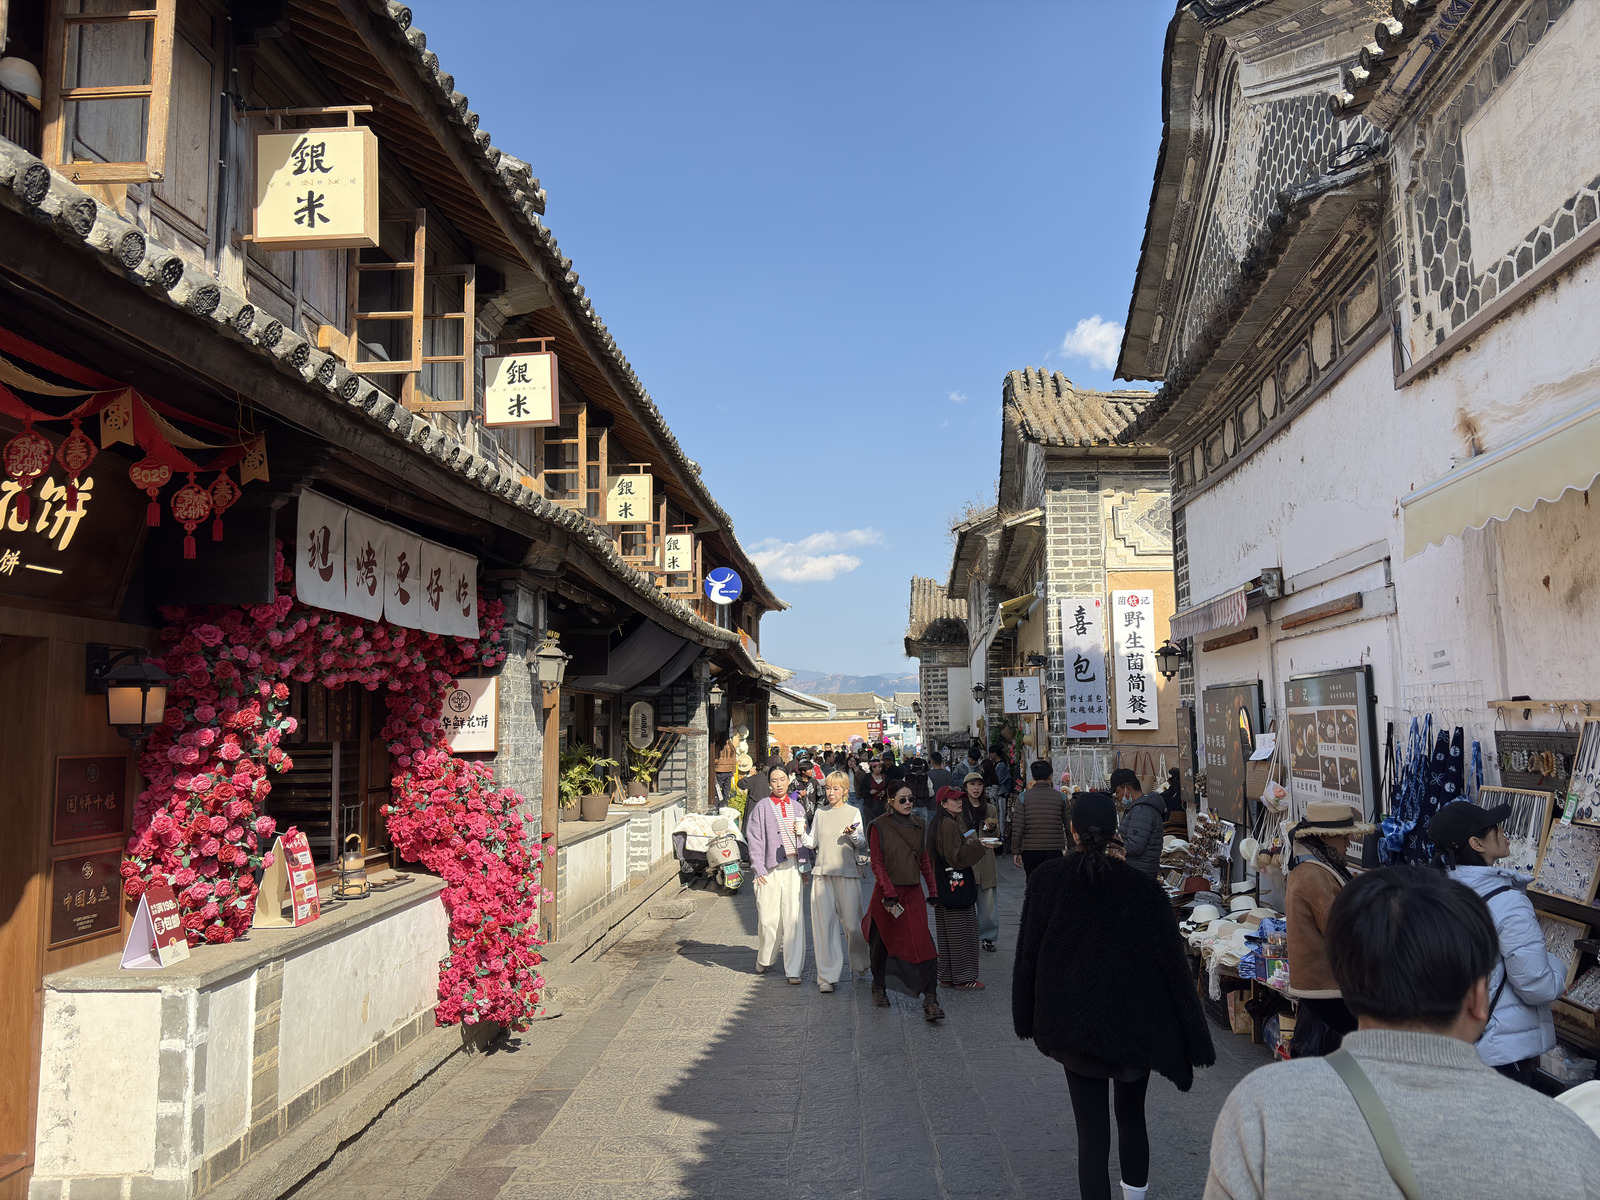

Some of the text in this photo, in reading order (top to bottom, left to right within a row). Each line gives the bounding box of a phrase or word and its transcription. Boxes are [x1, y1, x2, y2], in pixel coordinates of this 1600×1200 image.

[291, 137, 334, 228] 銀米
[506, 360, 532, 417] 銀米
[132, 465, 170, 483] 2026
[617, 478, 636, 519] 銀米
[308, 525, 471, 618] 现烤更好吃
[666, 537, 681, 569] 銀米
[1069, 605, 1096, 683] 喜包
[1123, 610, 1148, 714] 野生菌简餐
[1014, 678, 1029, 711] 喜包
[1069, 694, 1103, 703] 野生菌包
[439, 714, 489, 729] 华鲜花饼
